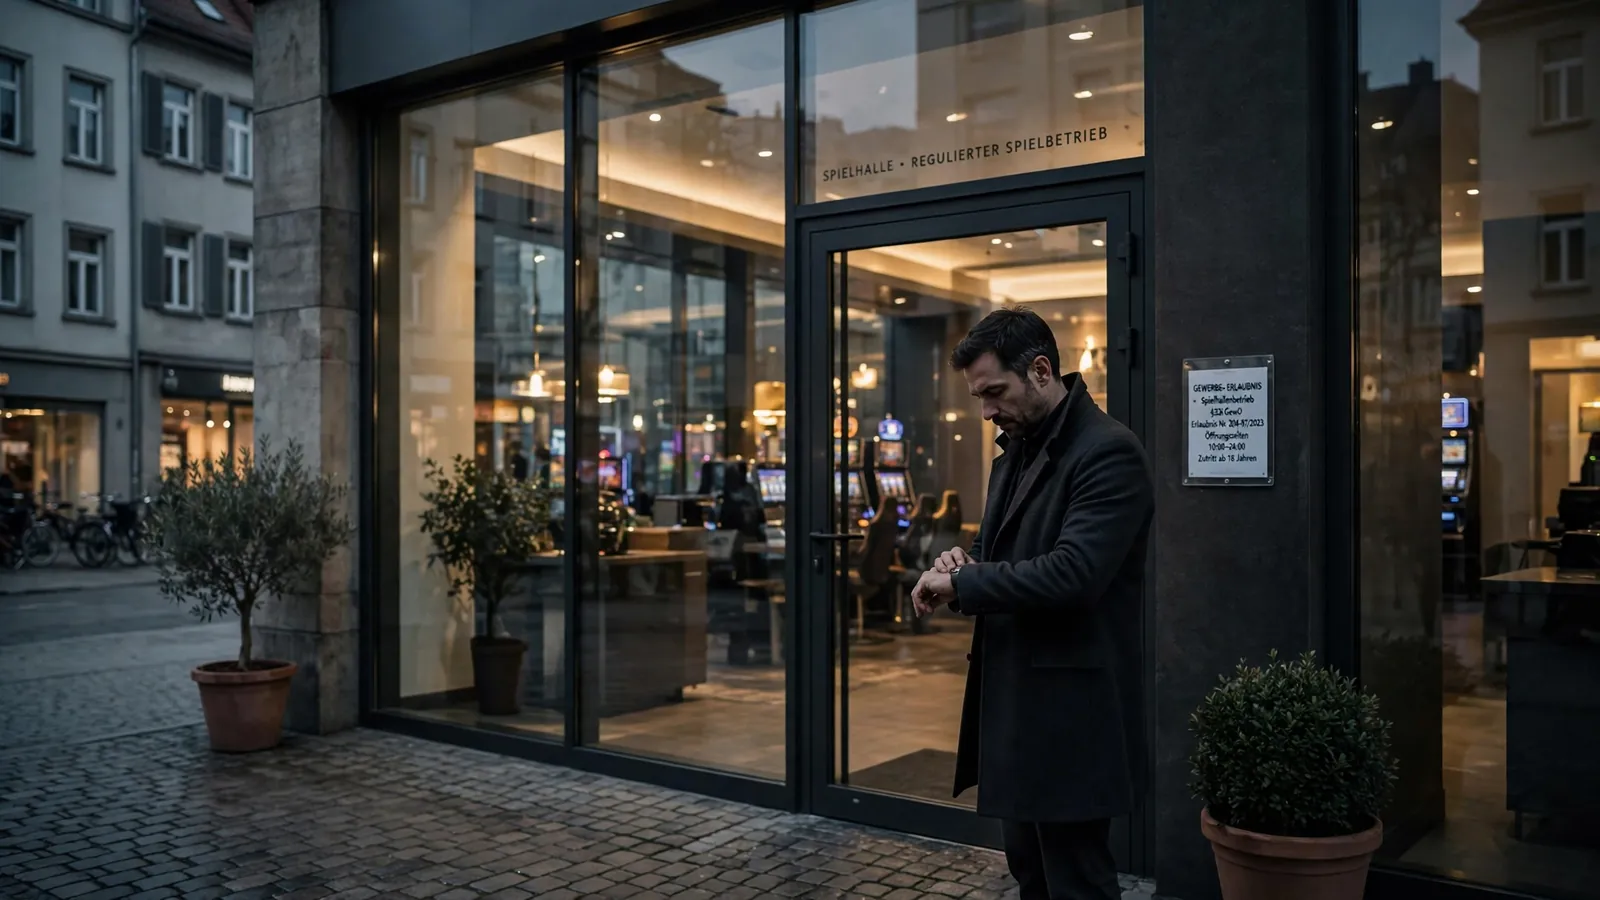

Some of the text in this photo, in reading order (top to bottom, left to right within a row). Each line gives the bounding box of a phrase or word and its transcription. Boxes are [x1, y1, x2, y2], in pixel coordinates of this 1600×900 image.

[823, 126, 1108, 182] SPIELHALLE REGULIERTER SPIELBETRIEB
[1193, 382, 1262, 392] GEWERBE- ERLAUBNIS
[1224, 407, 1243, 416] GewO
[1191, 420, 1218, 429] Erlaubnis
[1198, 453, 1257, 463] Zutritt ab 18 Jahren
